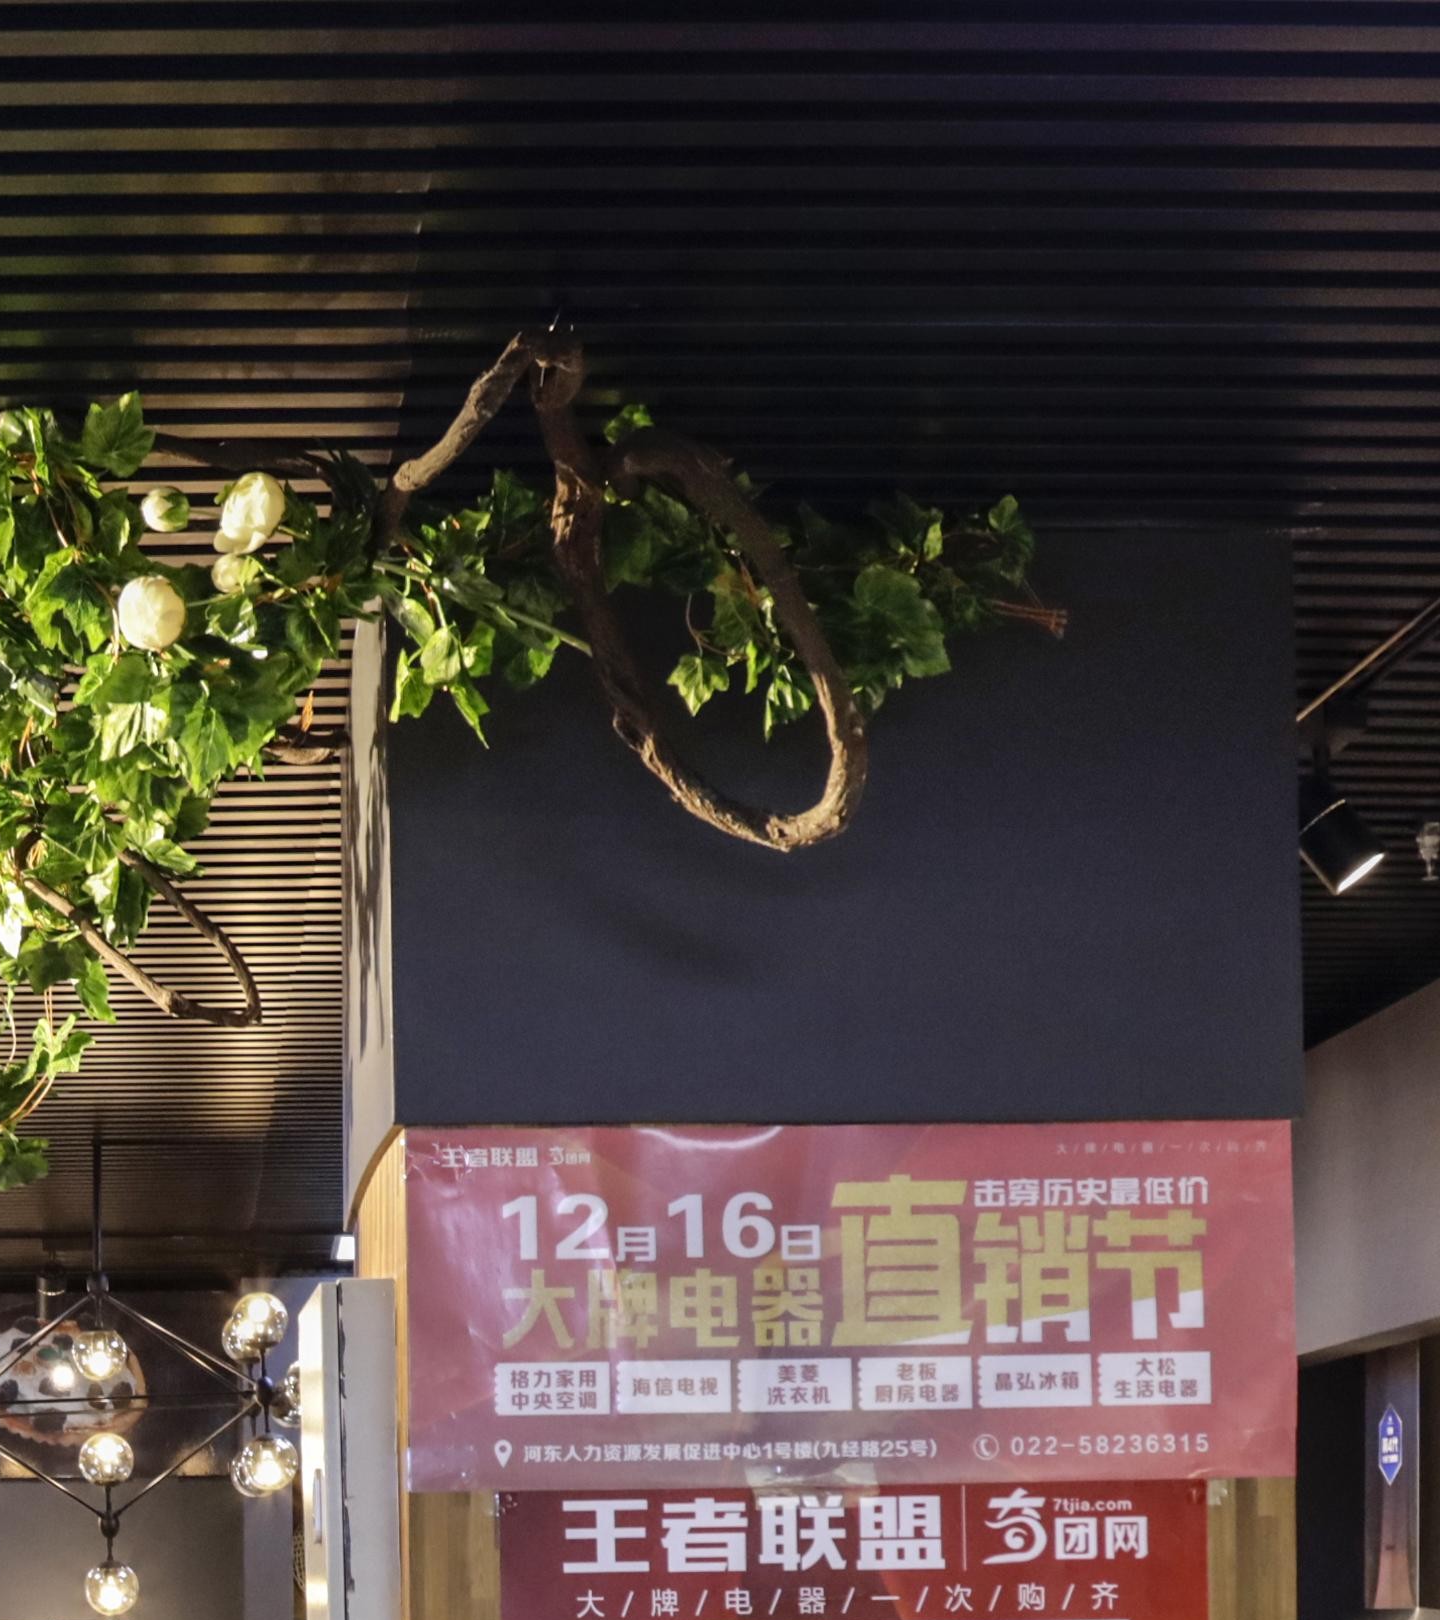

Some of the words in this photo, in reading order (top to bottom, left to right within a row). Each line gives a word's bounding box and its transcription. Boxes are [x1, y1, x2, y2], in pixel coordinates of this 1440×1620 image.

[442, 1147, 539, 1167] 王者联盟
[974, 1176, 1208, 1207] 击穿历史最低价
[501, 1192, 820, 1262] 12月16日
[831, 1174, 1208, 1347] 直销节
[501, 1267, 824, 1349] 大牌电器
[777, 1363, 820, 1383] 美菱
[896, 1362, 937, 1382] 老板
[1135, 1358, 1176, 1377] 大松
[510, 1370, 597, 1389] 格力家用
[632, 1376, 719, 1397] 海信电视
[995, 1371, 1080, 1391] 晶弘冰箱
[1114, 1379, 1198, 1399] 生活电器
[511, 1391, 597, 1411] 中央空调
[767, 1386, 831, 1406] 洗衣机
[875, 1384, 959, 1403] 厨房电器
[1011, 1433, 1210, 1456] 022-58236315
[1053, 1498, 1132, 1515] 7tjia.com
[562, 1494, 946, 1574] 王者联盟
